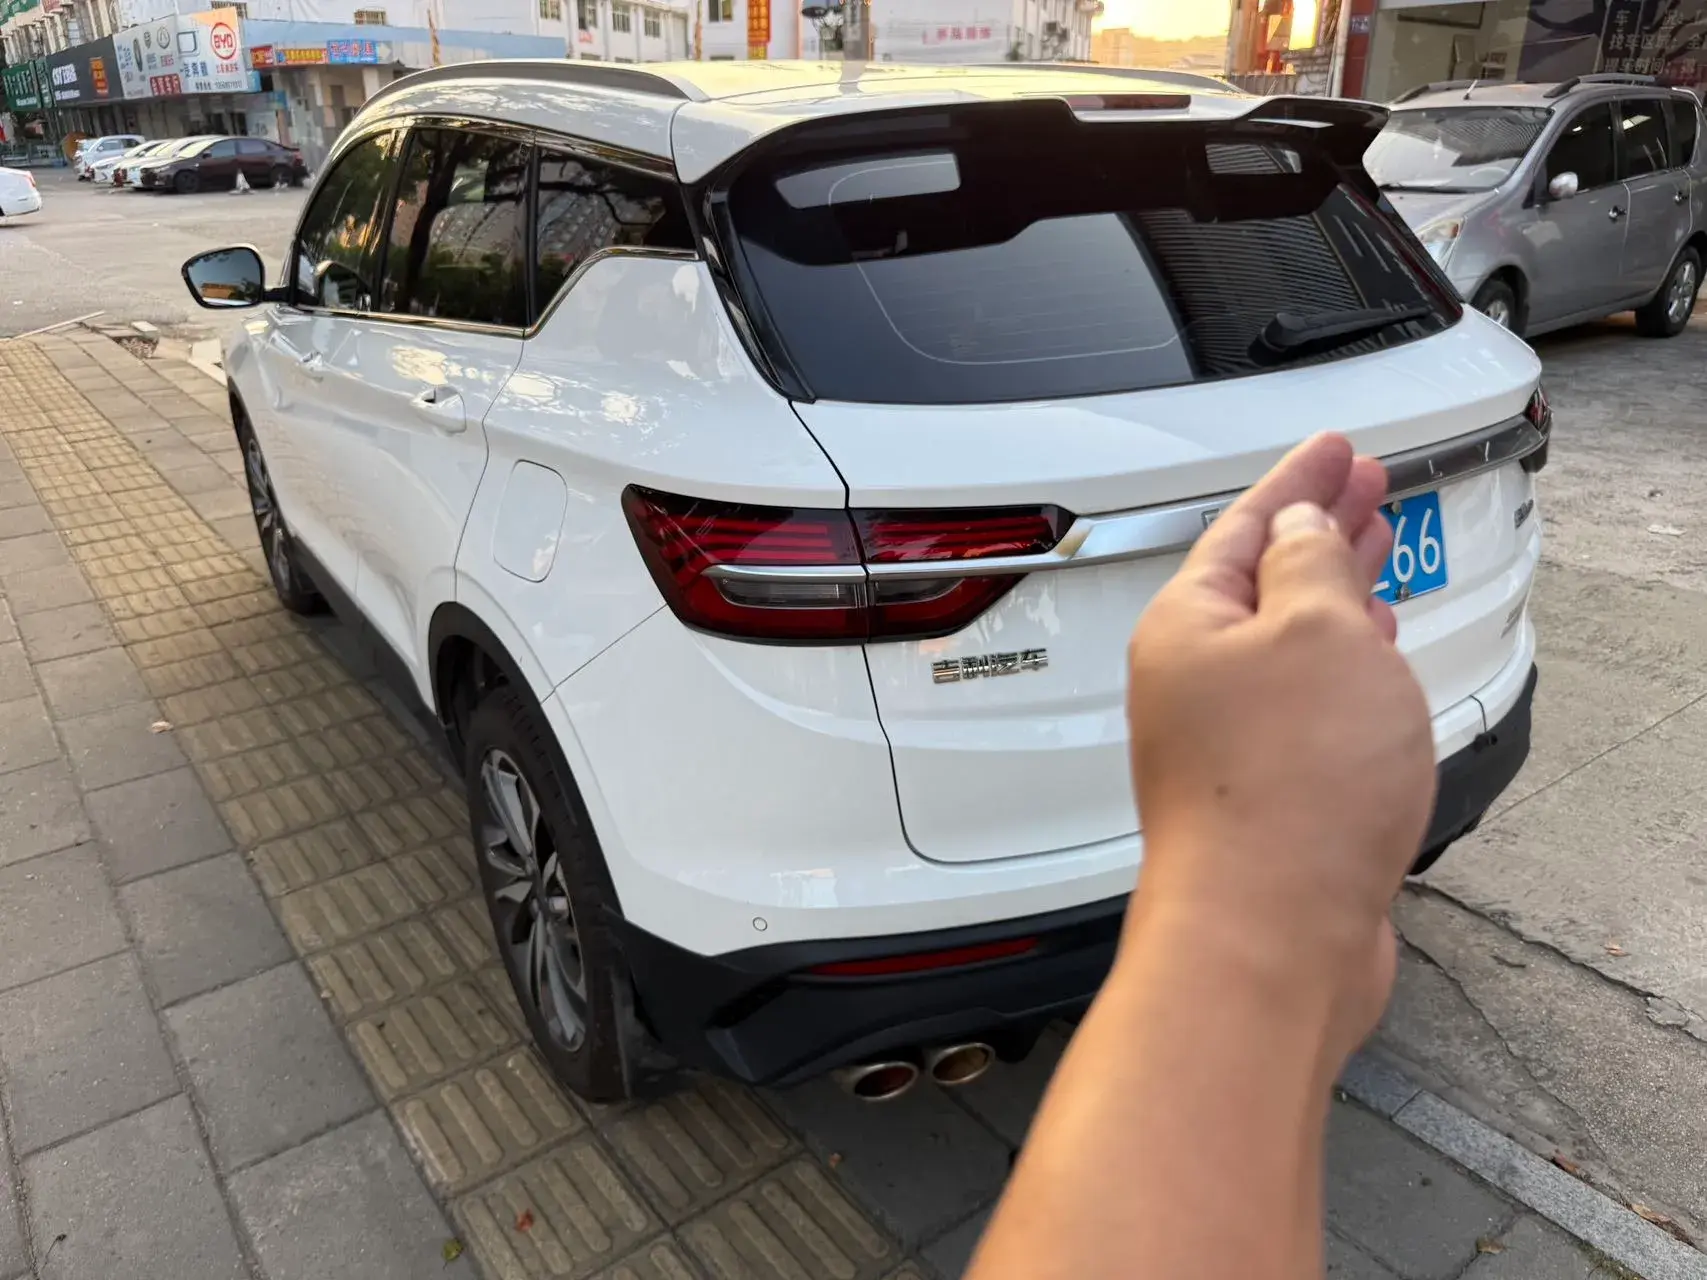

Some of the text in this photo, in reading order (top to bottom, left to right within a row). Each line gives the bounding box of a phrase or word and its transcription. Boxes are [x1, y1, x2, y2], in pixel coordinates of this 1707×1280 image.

[213, 33, 234, 49] BYD
[1371, 508, 1441, 593] 66
[932, 648, 1048, 684] 吉利汽车
